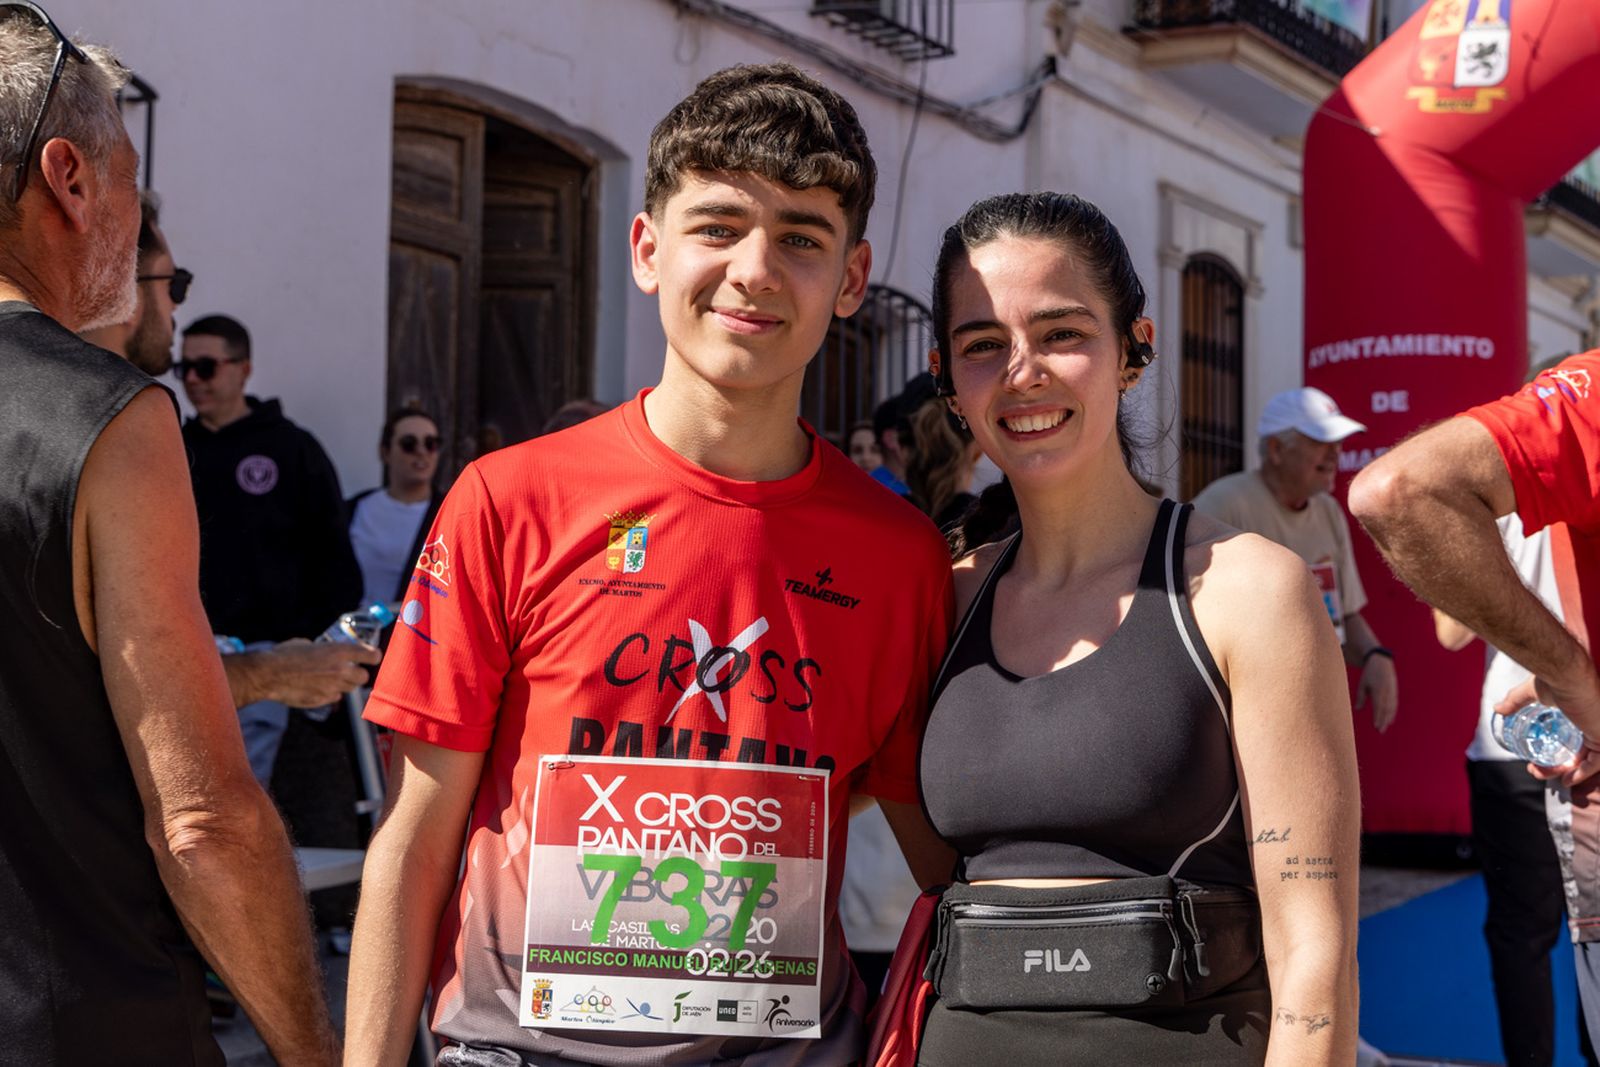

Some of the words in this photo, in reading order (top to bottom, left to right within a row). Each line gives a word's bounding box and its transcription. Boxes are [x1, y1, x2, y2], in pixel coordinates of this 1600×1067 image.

[1309, 334, 1495, 369] AYUNTAMIENTO
[1371, 391, 1409, 413] DE
[608, 579, 665, 591] AYUNTAMIENTO
[612, 588, 642, 598] MARTOS
[784, 579, 861, 609] TEAMERGY
[603, 632, 822, 712] CROSS
[578, 773, 627, 823] X
[634, 792, 782, 833] CROSS
[576, 825, 748, 863] PANTANO
[753, 841, 780, 857] DEL
[1286, 855, 1299, 865] ad
[1305, 857, 1334, 865] astra
[1280, 871, 1299, 882] per
[582, 853, 777, 951] 737
[529, 948, 628, 967] FRANCISCO
[633, 953, 704, 971] MANUEL
[709, 956, 750, 973] RUIZ
[753, 960, 817, 976] ARENAS
[1023, 948, 1092, 973] FILA
[775, 1017, 816, 1028] Aniversario
